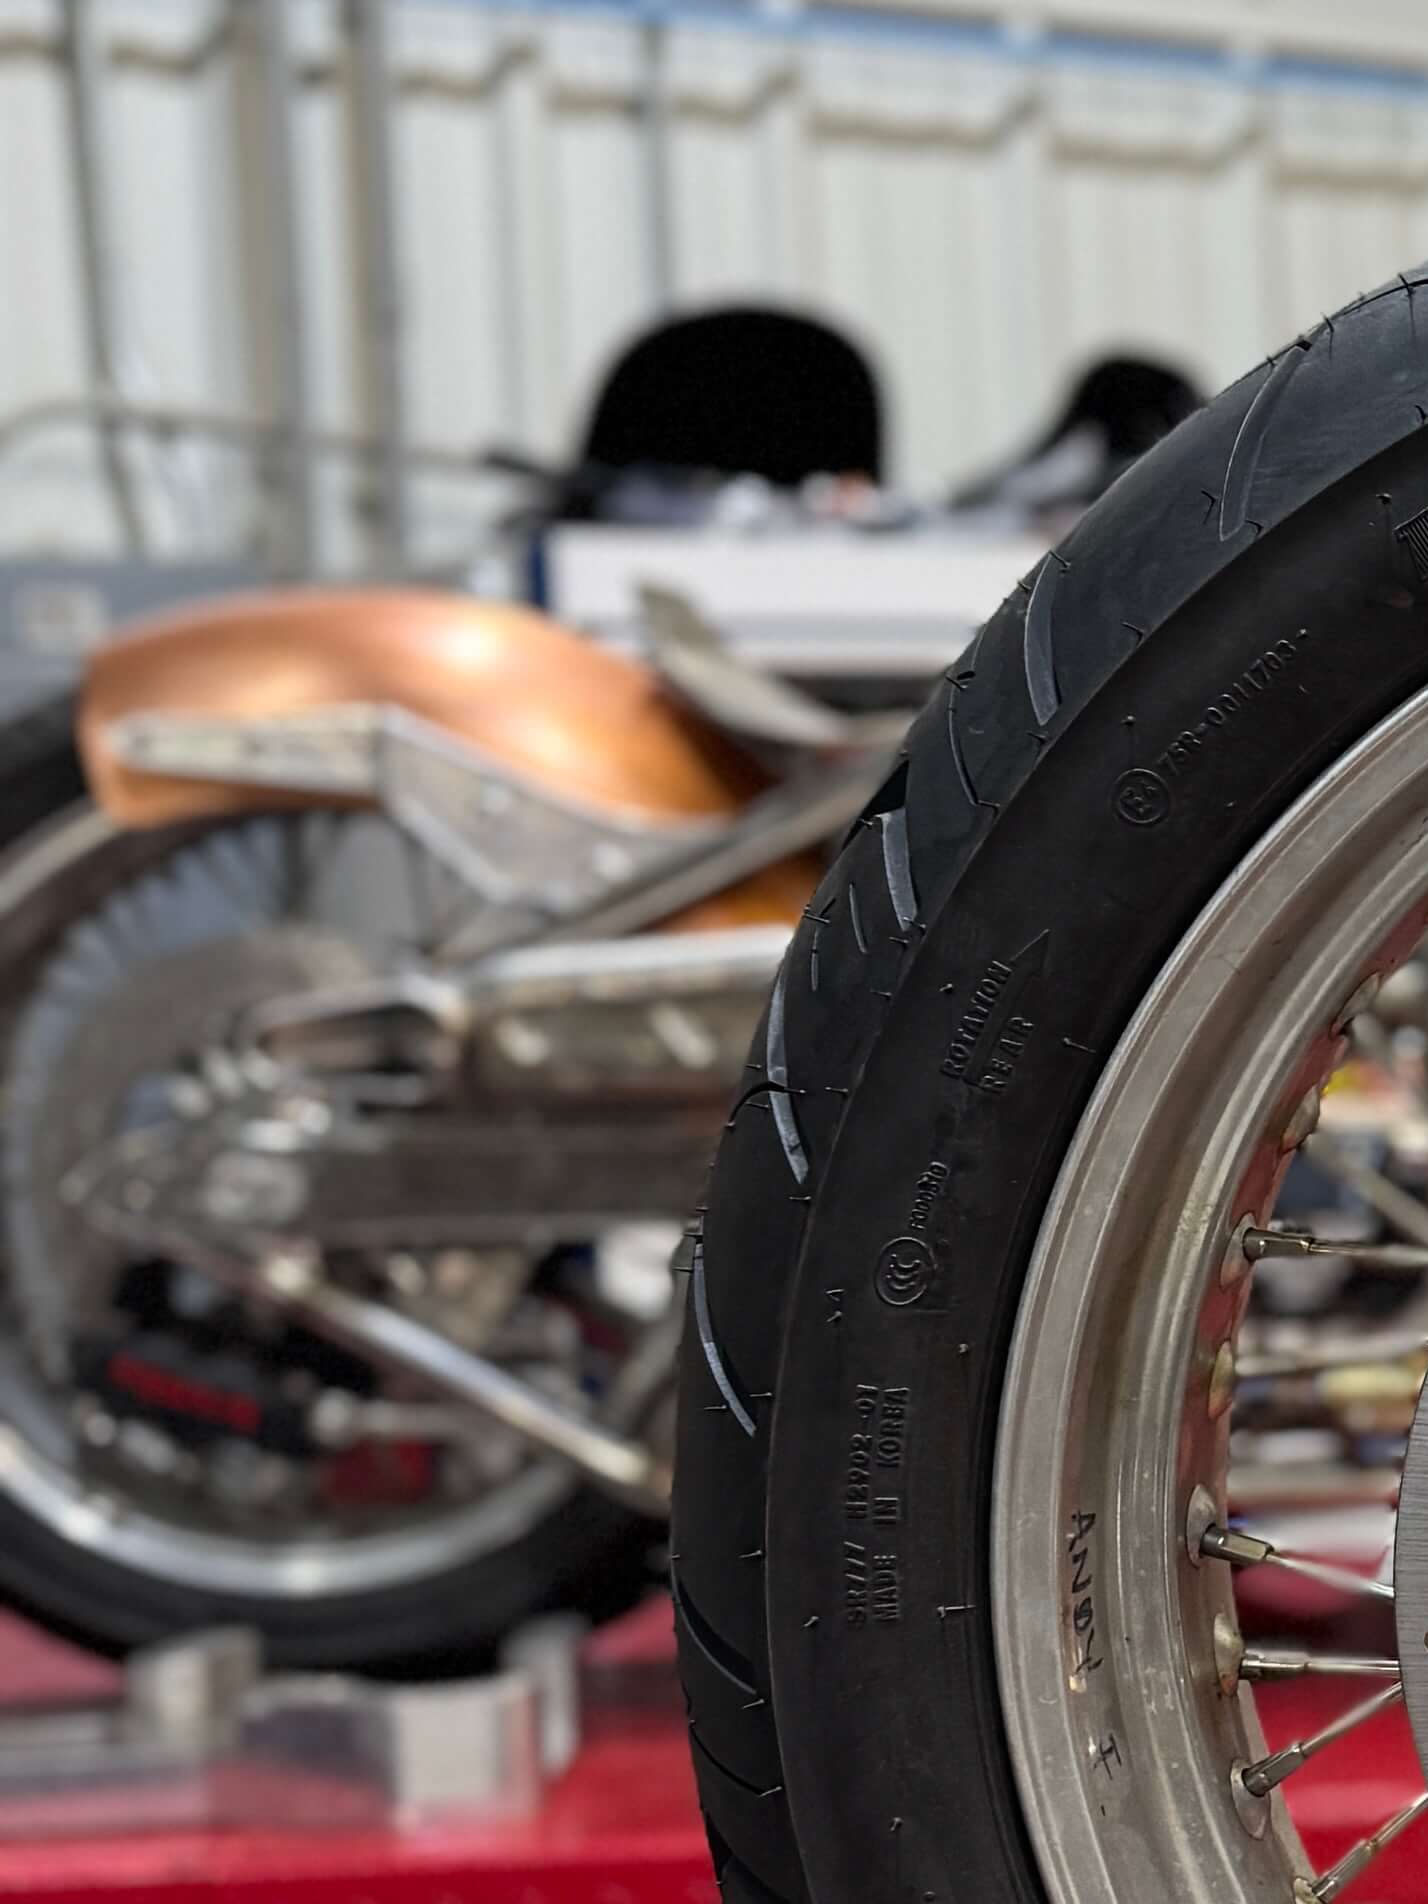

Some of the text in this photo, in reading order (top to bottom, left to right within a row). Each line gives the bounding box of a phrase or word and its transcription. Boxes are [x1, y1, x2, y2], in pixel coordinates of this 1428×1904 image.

[941, 958, 1012, 1081] ROTATION
[983, 1015, 1037, 1096] REAR
[875, 1383, 911, 1469] KOREA
[871, 1551, 899, 1623] MADE
